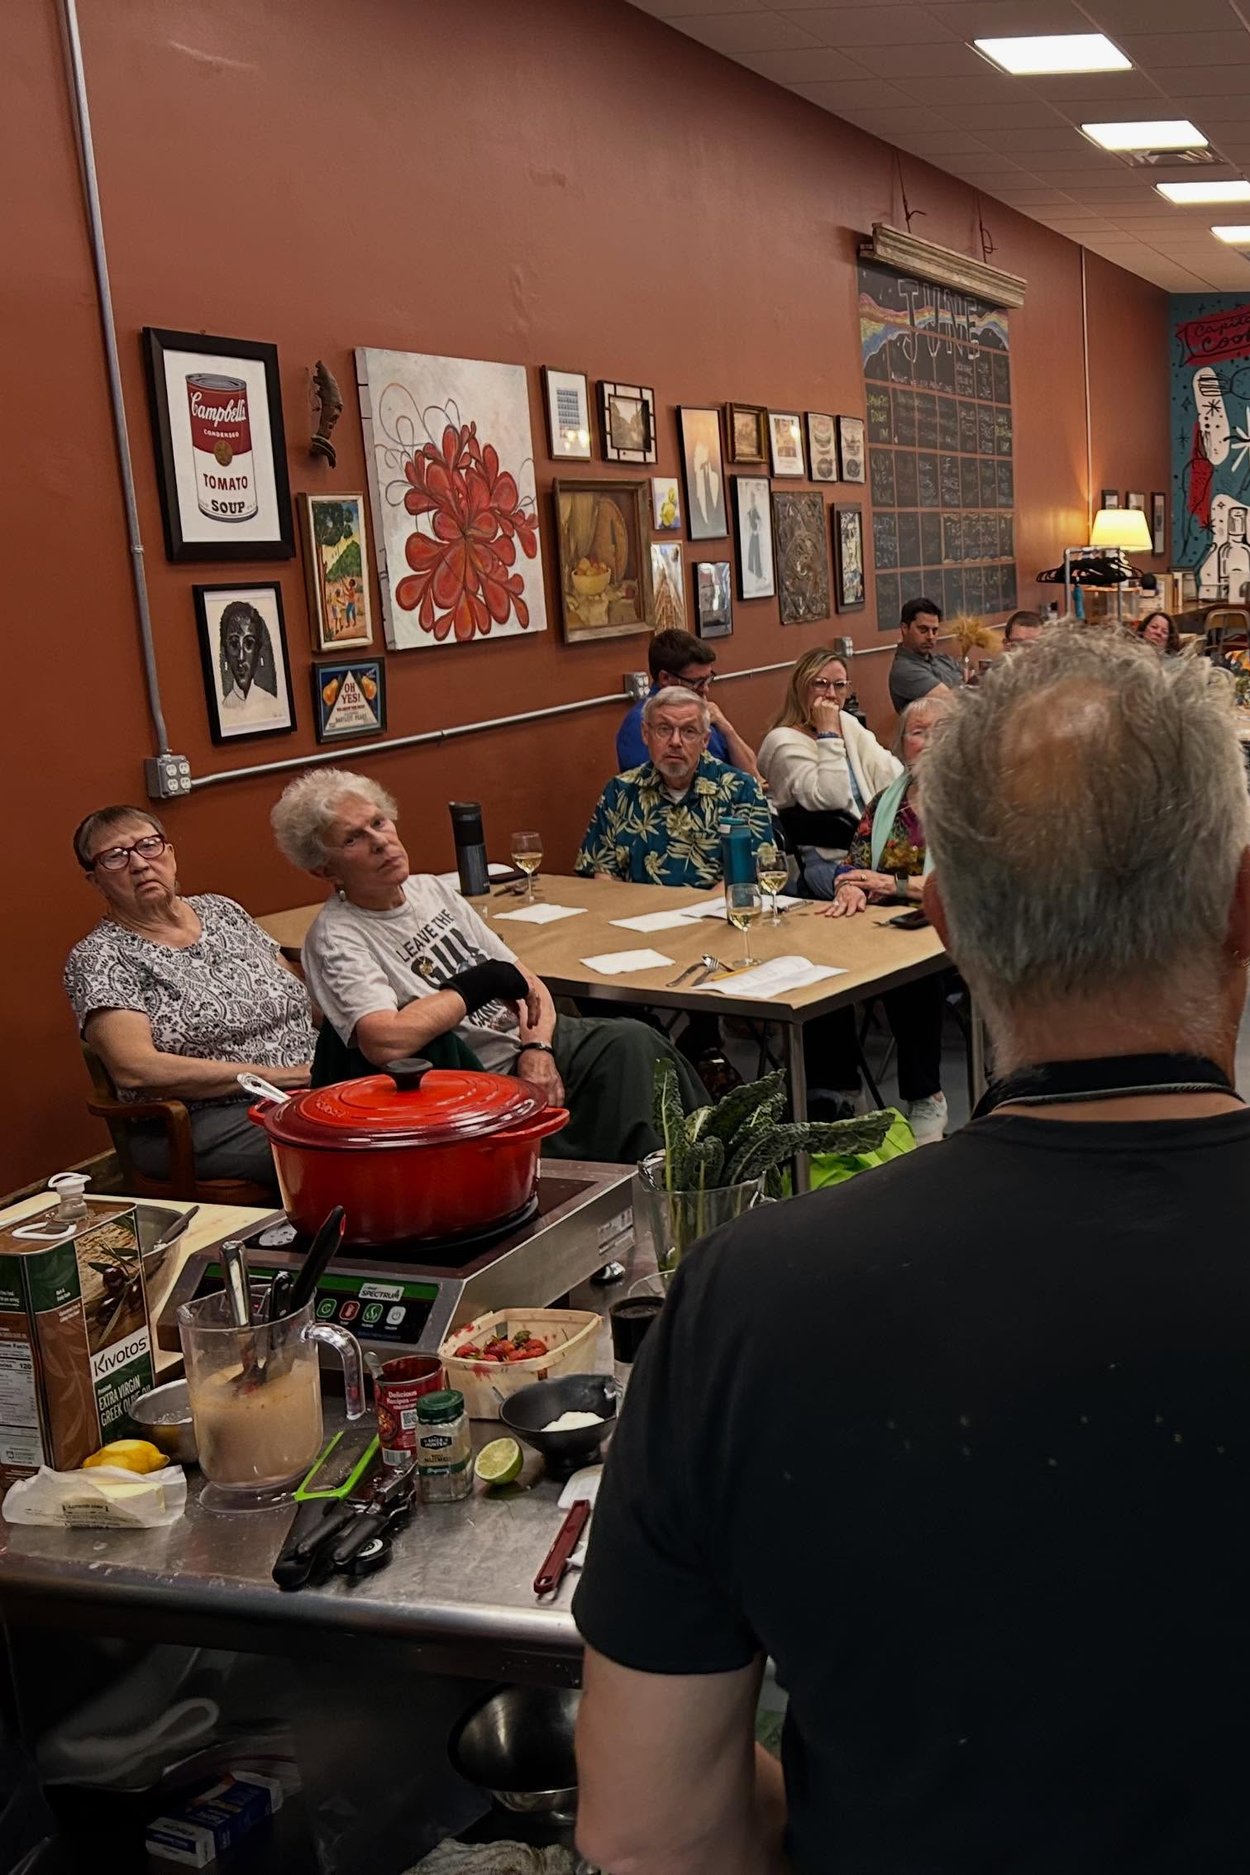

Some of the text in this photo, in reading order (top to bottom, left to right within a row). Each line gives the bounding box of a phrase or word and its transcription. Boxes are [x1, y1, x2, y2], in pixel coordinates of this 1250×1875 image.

[898, 279, 981, 363] JUNE
[203, 428, 240, 439] CONDENSED
[203, 473, 248, 491] TOMATO
[211, 499, 245, 514] SOUP
[344, 682, 356, 693] OH
[341, 693, 361, 705] YES!
[396, 908, 455, 962] LEAVE THE
[362, 1289, 401, 1299] SPECTRUM
[93, 1336, 148, 1377] Kivotos
[98, 1374, 141, 1411] EXTRA VIRGIN
[388, 1390, 418, 1398] Delicious
[100, 1403, 124, 1427] GREEK
